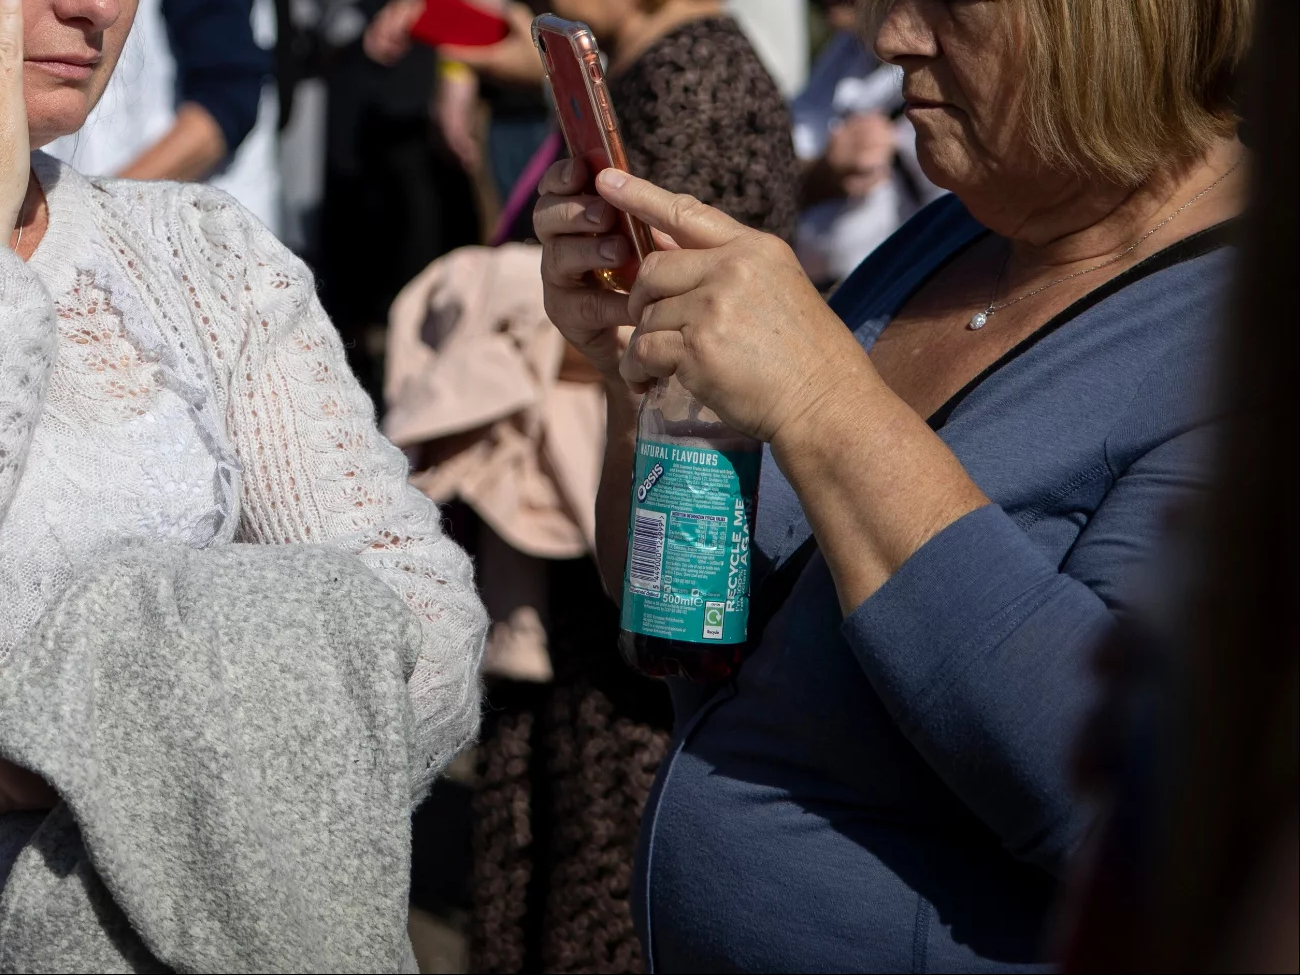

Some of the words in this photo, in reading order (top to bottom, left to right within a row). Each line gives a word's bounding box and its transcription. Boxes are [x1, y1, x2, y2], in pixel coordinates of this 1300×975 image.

[640, 443, 668, 460] NATURAL
[671, 448, 718, 466] FLAVOURS
[733, 498, 744, 526] ME
[726, 532, 741, 612] RECYCLE
